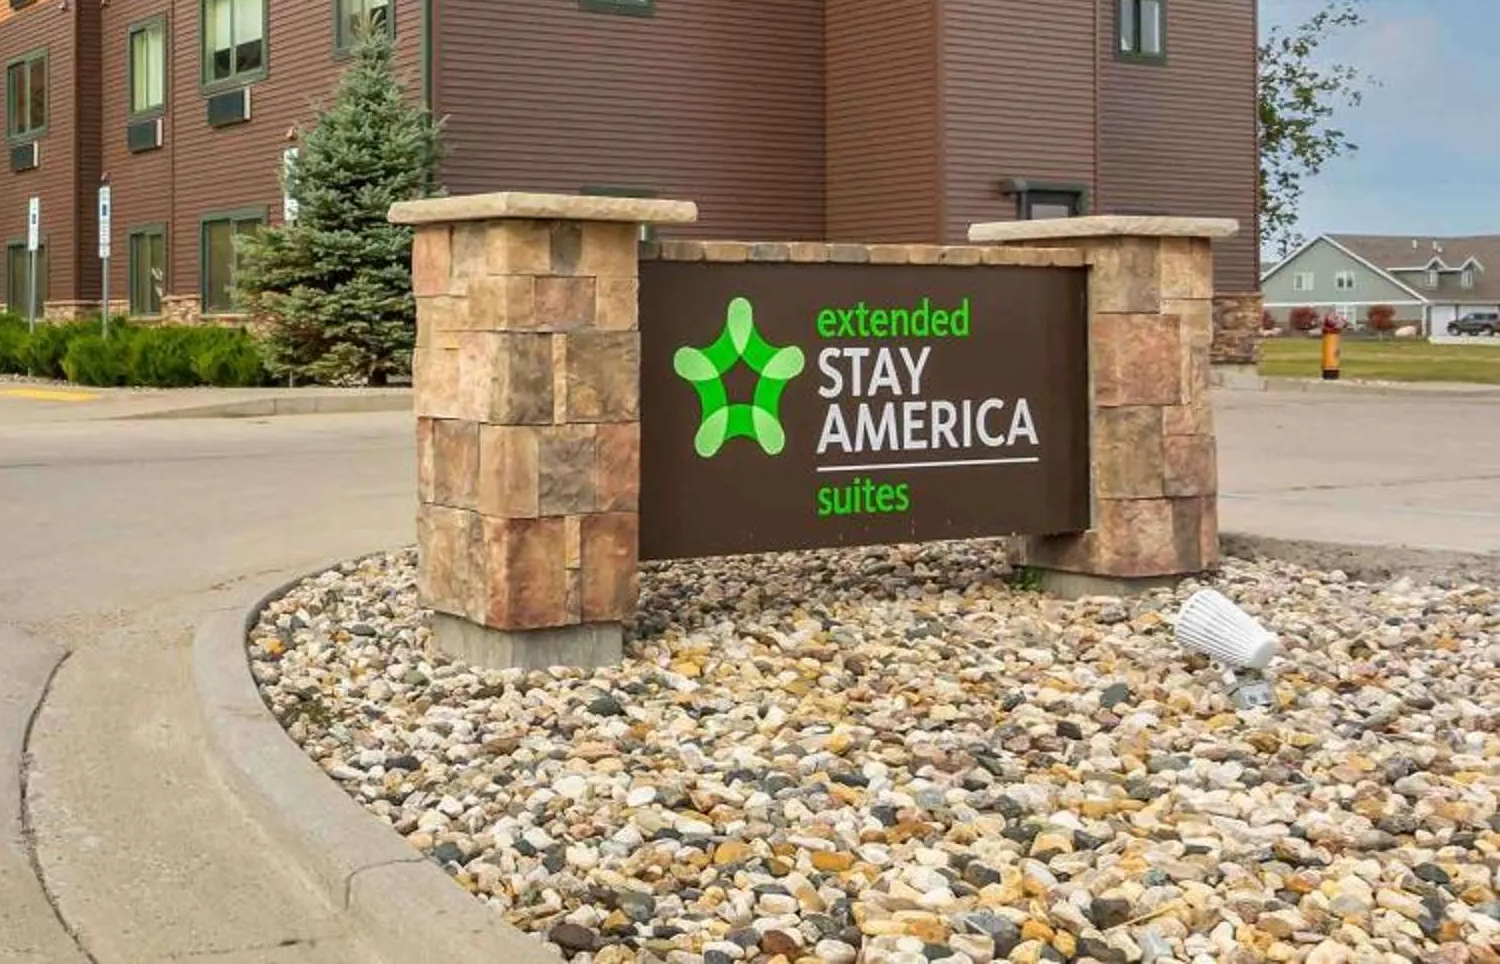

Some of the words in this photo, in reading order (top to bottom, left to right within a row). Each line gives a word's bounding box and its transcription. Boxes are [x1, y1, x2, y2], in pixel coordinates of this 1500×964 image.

[817, 298, 970, 337] extended
[818, 346, 932, 398] STAY
[816, 397, 1040, 454] AMERICA
[817, 477, 910, 516] suites
